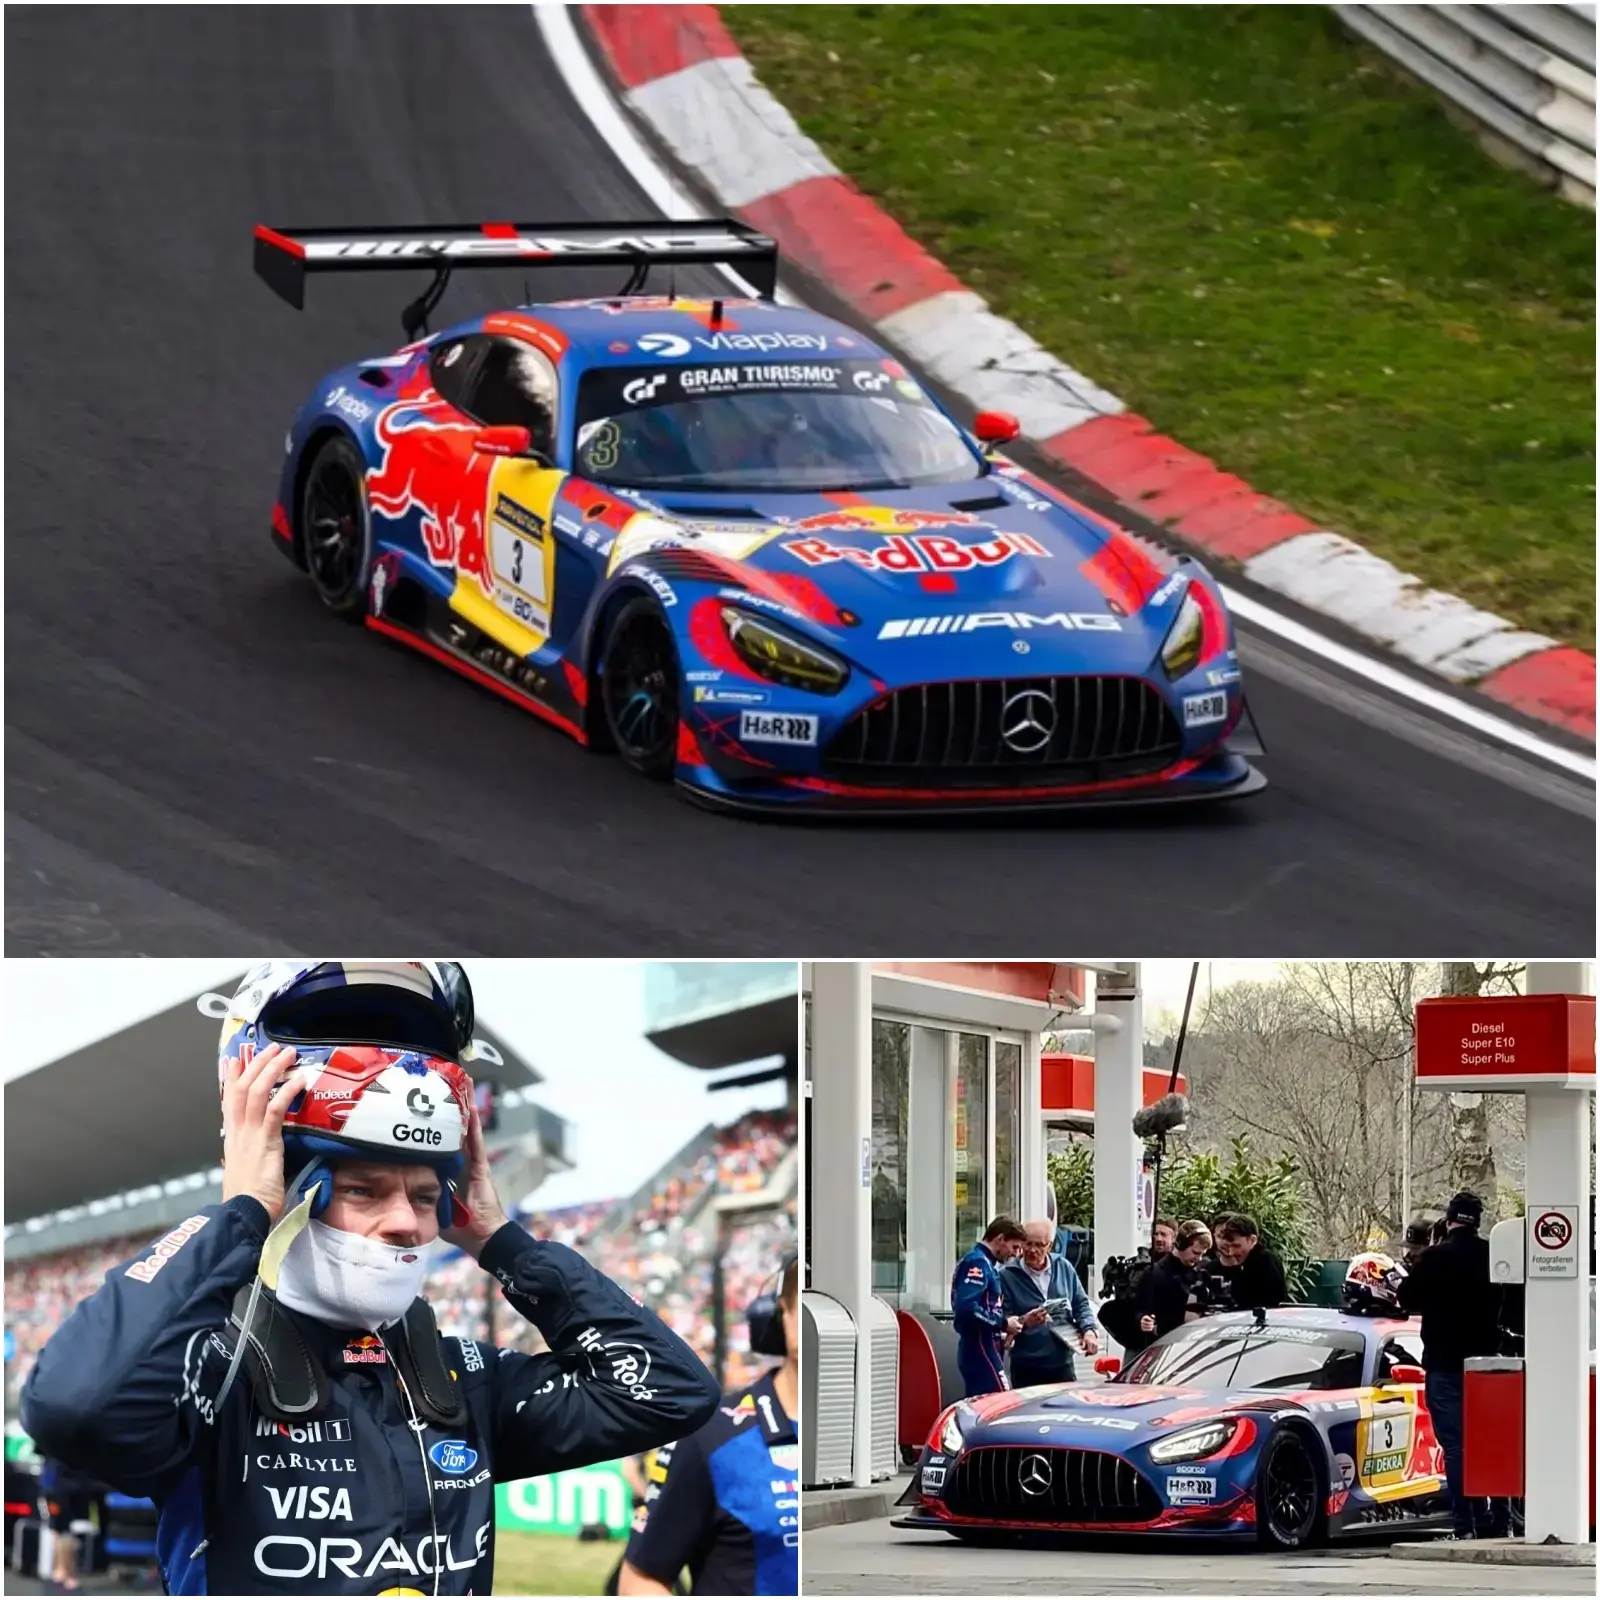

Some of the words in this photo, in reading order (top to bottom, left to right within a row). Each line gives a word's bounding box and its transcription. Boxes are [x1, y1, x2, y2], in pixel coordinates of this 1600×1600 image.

[693, 332, 828, 352] viaplay
[680, 366, 738, 388] GRAN
[743, 364, 835, 384] TURISMO
[588, 420, 620, 469] 3
[512, 539, 523, 584] 3
[912, 532, 1053, 572] Bull
[960, 611, 1123, 632] AMG
[743, 715, 786, 737] H&R
[1471, 1022, 1505, 1034] Diesel
[1461, 1037, 1493, 1051] Super
[1495, 1036, 1516, 1048] E10
[1461, 1053, 1493, 1067] Super
[1494, 1052, 1516, 1063] Plus
[313, 1089, 353, 1101] indeed
[392, 1123, 442, 1146] Gate
[1532, 1255, 1574, 1265] Fotografieren
[1538, 1265, 1567, 1273] verboten
[612, 1354, 659, 1402] Rock
[331, 1421, 343, 1440] 1
[1384, 1420, 1394, 1448] 3
[256, 1453, 357, 1472] CARLYLE
[1376, 1454, 1404, 1473] DEKRA
[1169, 1480, 1195, 1492] H&R
[262, 1485, 354, 1522] VISA
[253, 1521, 491, 1579] ORACLE
